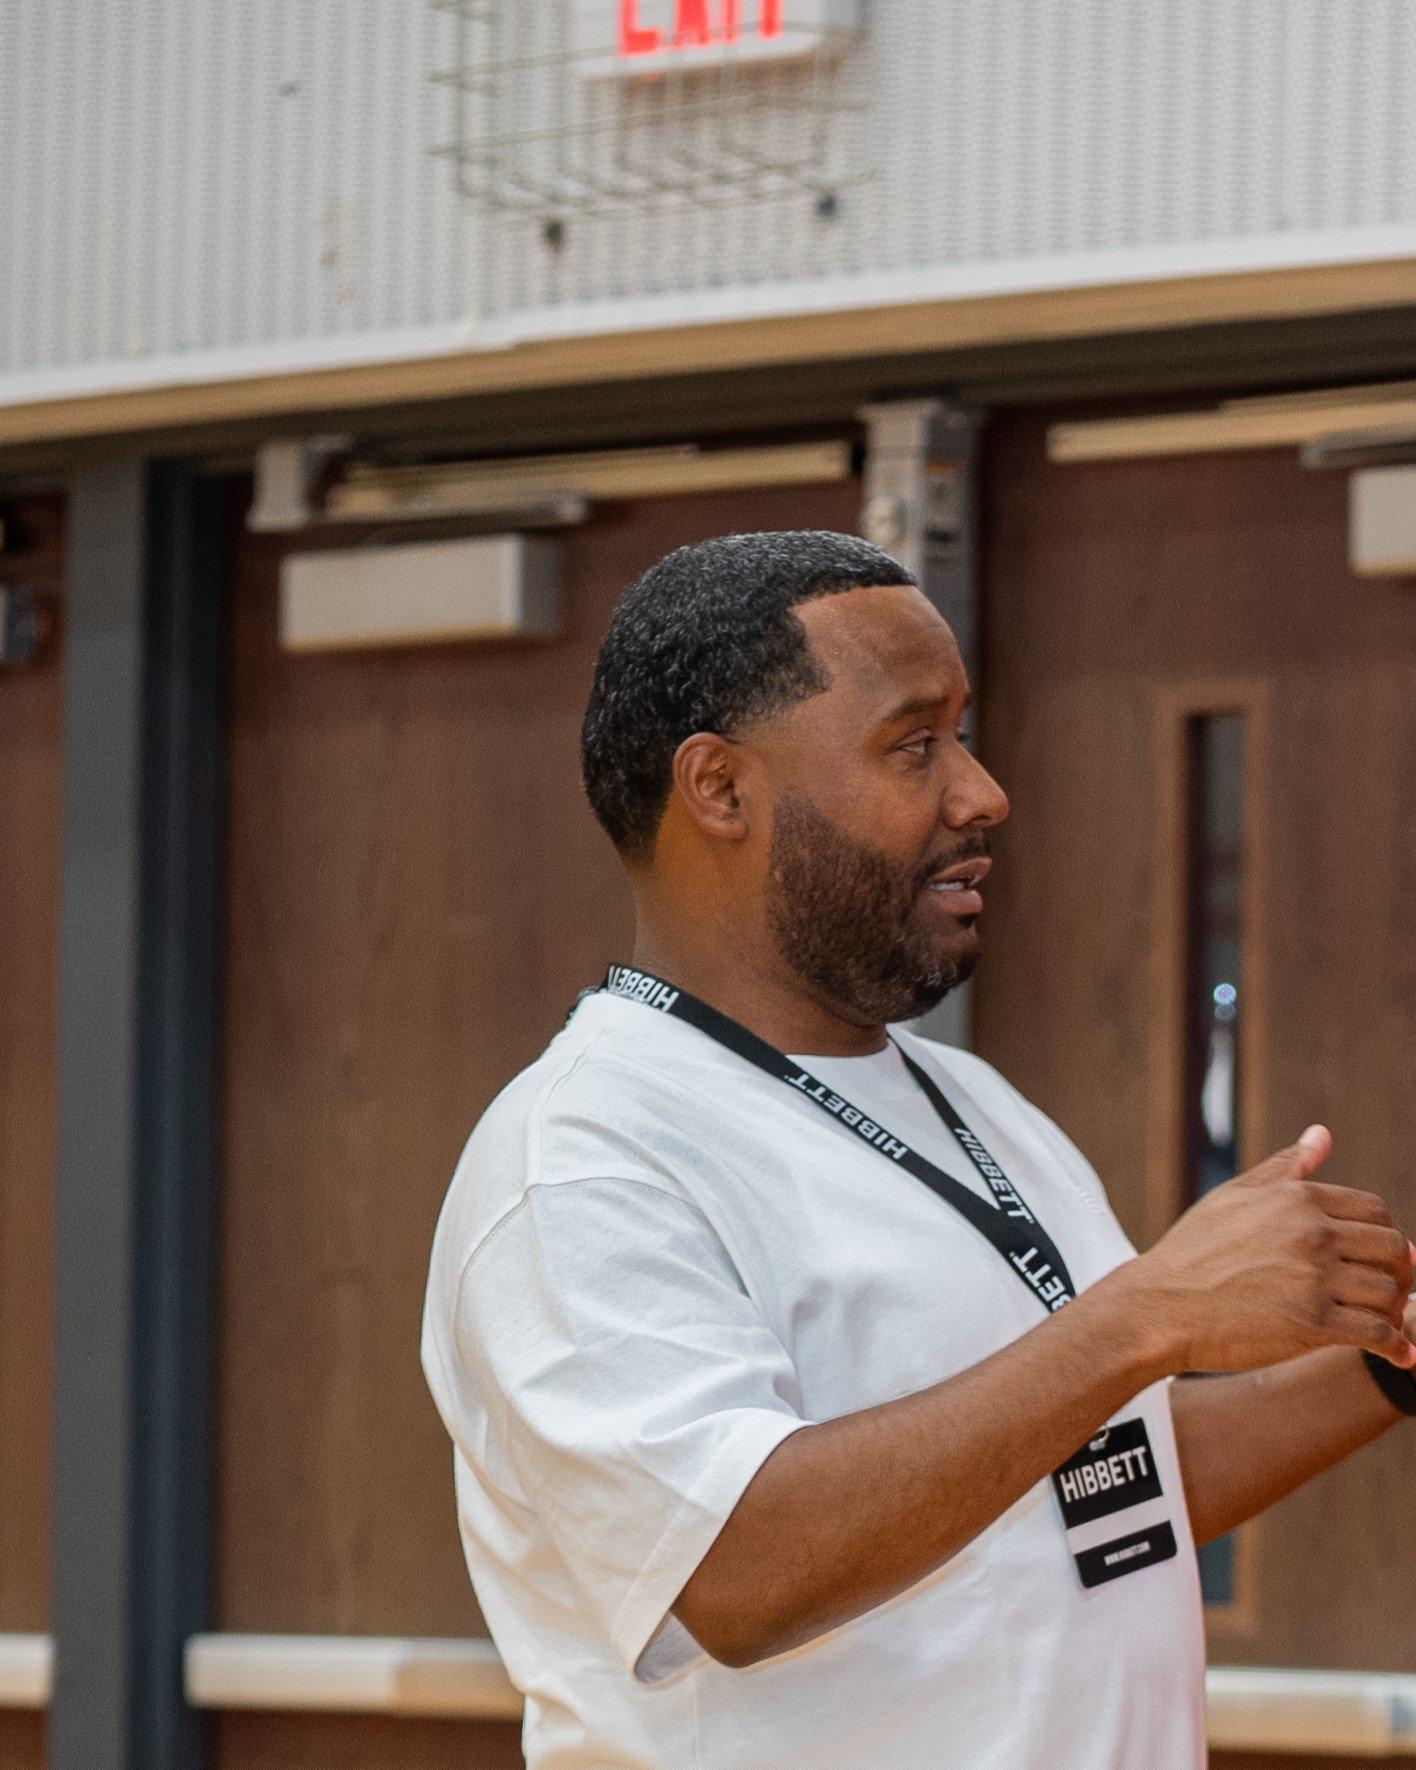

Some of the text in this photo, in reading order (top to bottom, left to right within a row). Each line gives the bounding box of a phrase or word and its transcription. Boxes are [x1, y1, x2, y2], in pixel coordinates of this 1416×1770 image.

[787, 1073, 908, 1160] HIBBETT
[954, 1126, 1034, 1224] HIBBETT
[1010, 1246, 1072, 1311] BETT
[1058, 1445, 1151, 1504] HIBBETT
